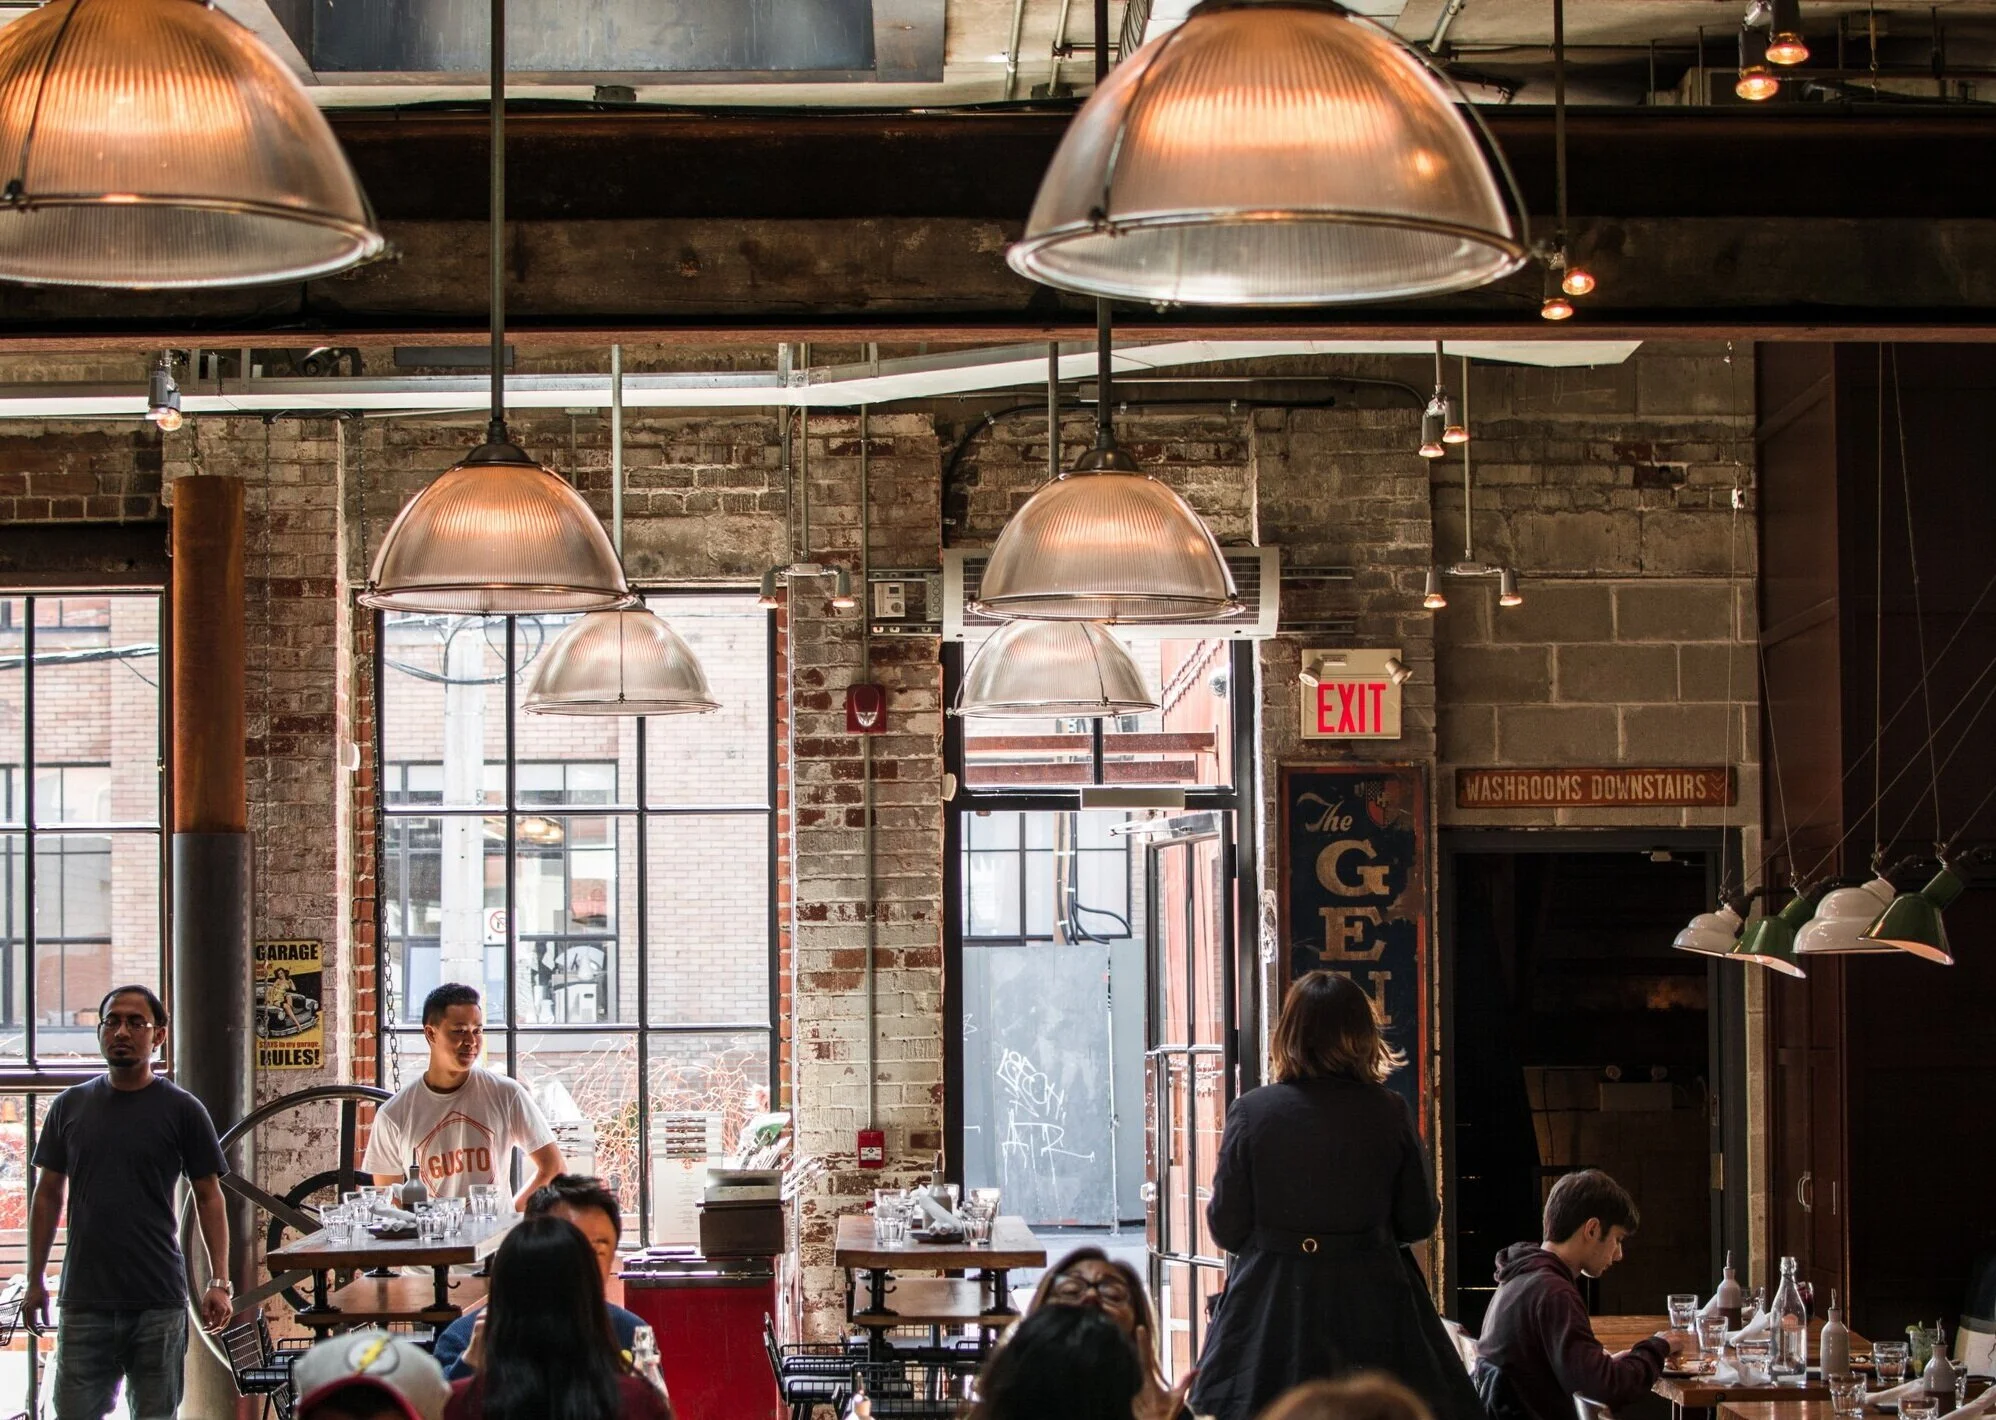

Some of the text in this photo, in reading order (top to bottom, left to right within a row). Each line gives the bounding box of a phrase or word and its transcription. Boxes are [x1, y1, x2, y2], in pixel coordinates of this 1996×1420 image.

[1317, 683, 1387, 733] EXIT
[1465, 774, 1706, 801] WASHROOMS DOWNSTAIRS
[1296, 792, 1353, 832] The
[256, 944, 318, 960] GARAGE
[260, 1049, 320, 1066] RULES!
[428, 1147, 491, 1179] GUSTO
